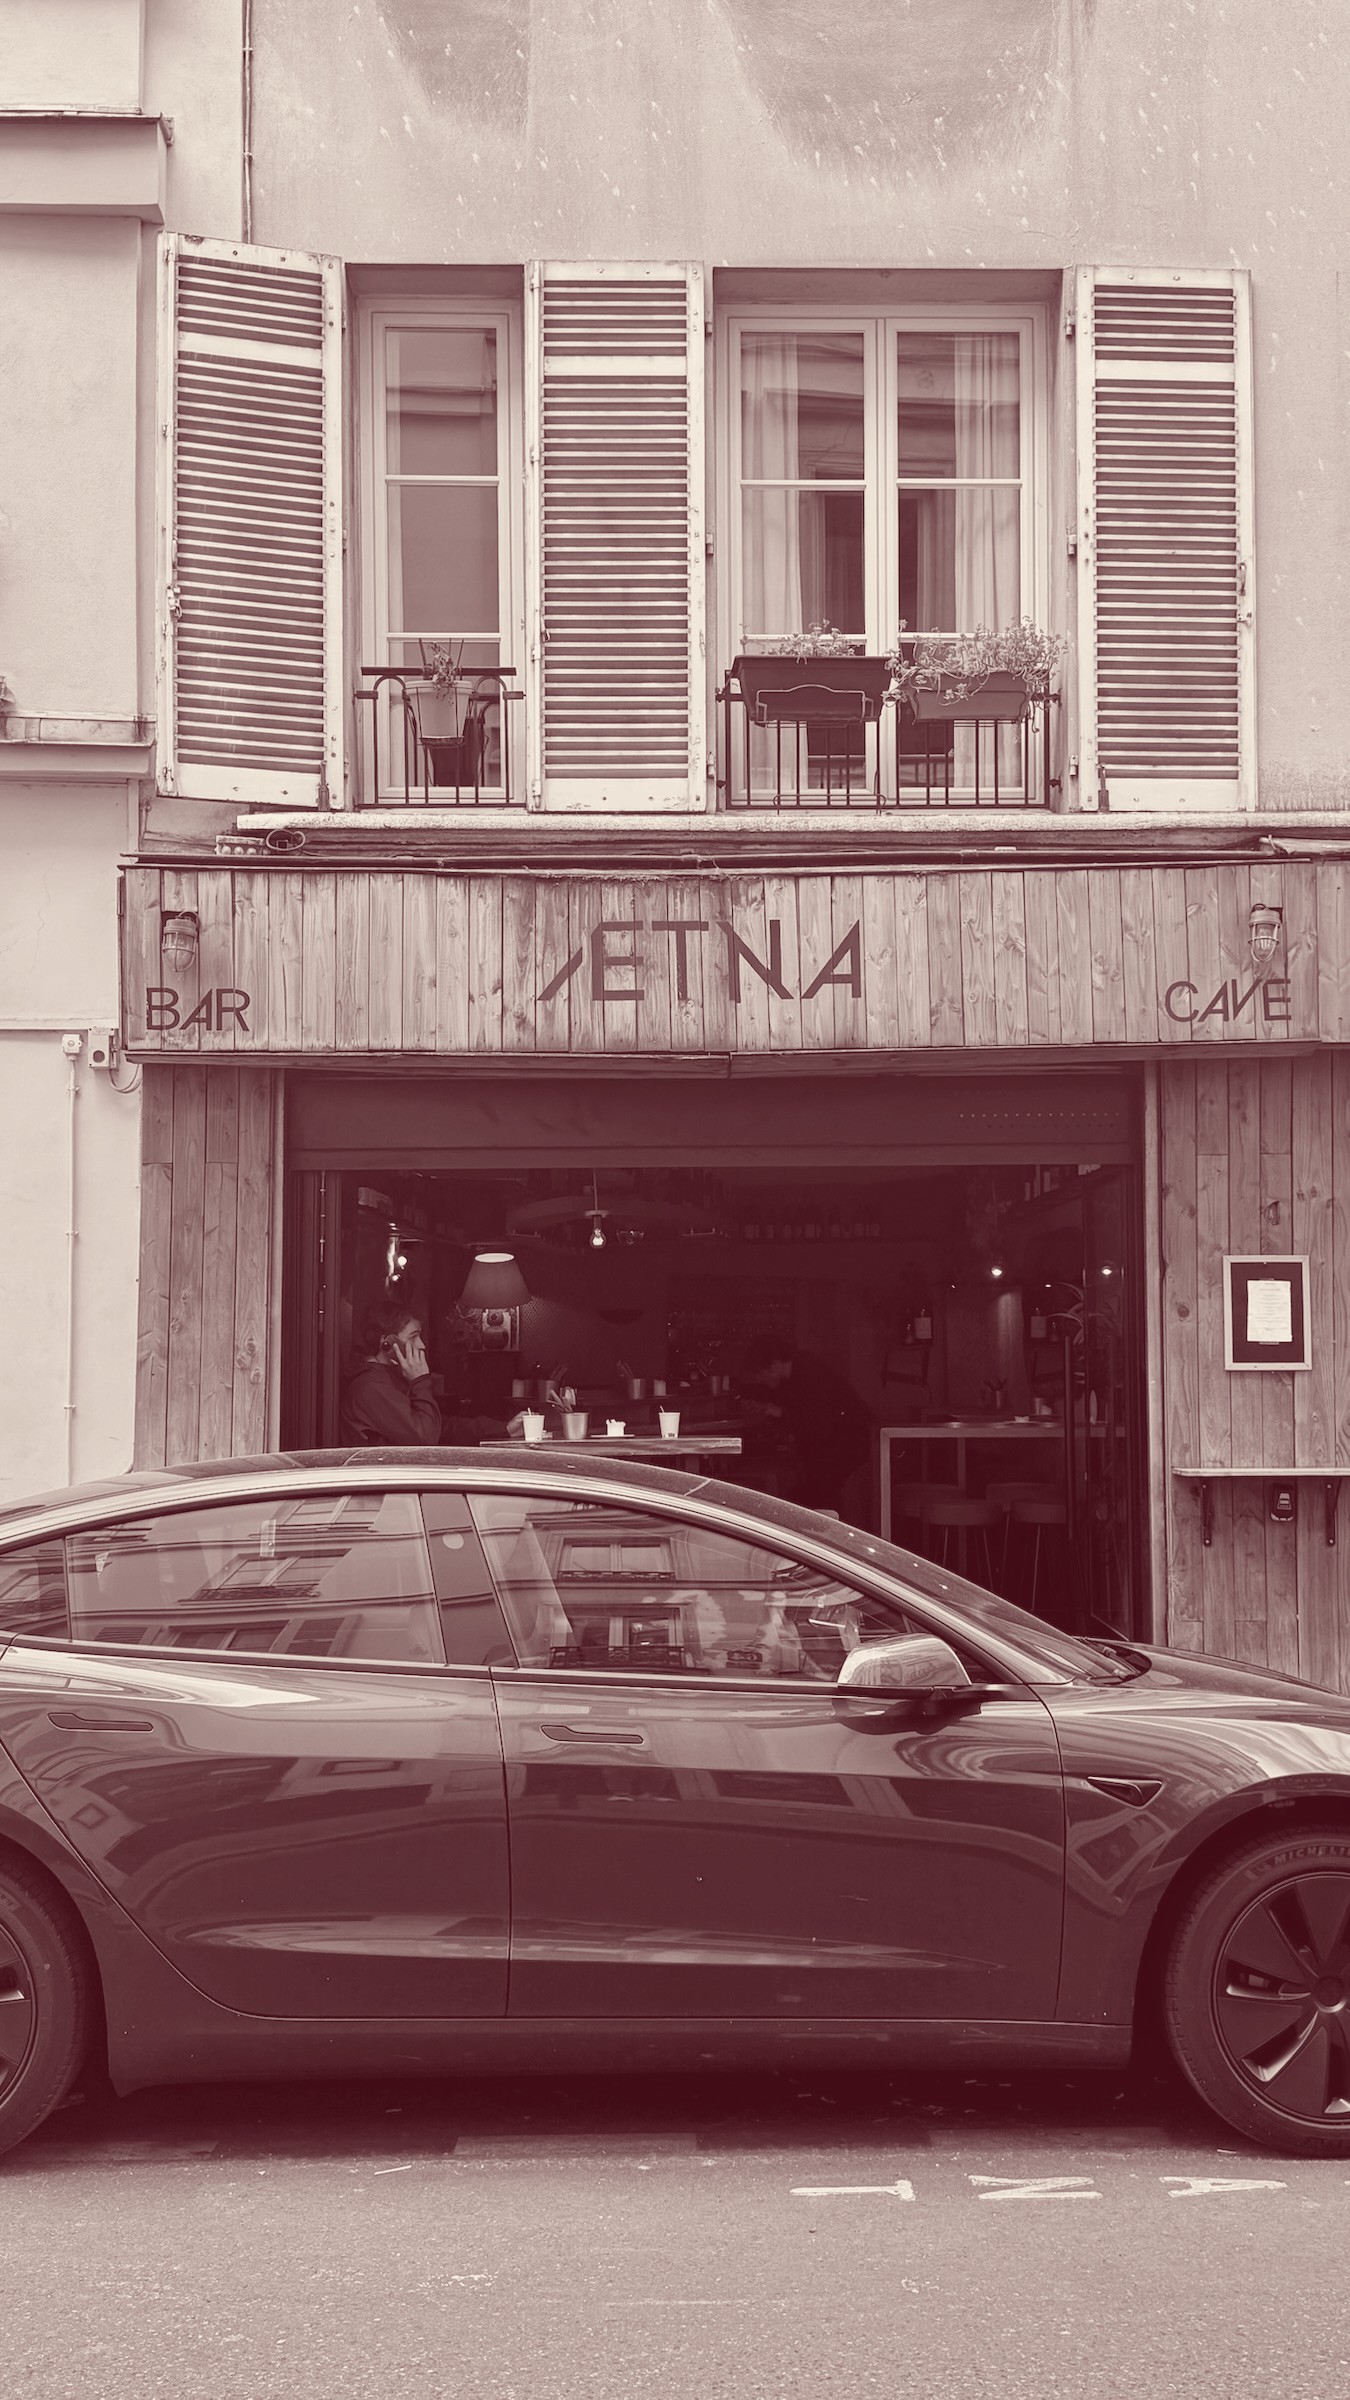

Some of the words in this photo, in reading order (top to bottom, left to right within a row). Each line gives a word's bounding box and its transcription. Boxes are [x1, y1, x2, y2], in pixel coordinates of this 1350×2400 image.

[146, 987, 251, 1032] BAR
[1165, 978, 1292, 1022] CAVE
[1273, 1846, 1350, 1866] MICHELI
